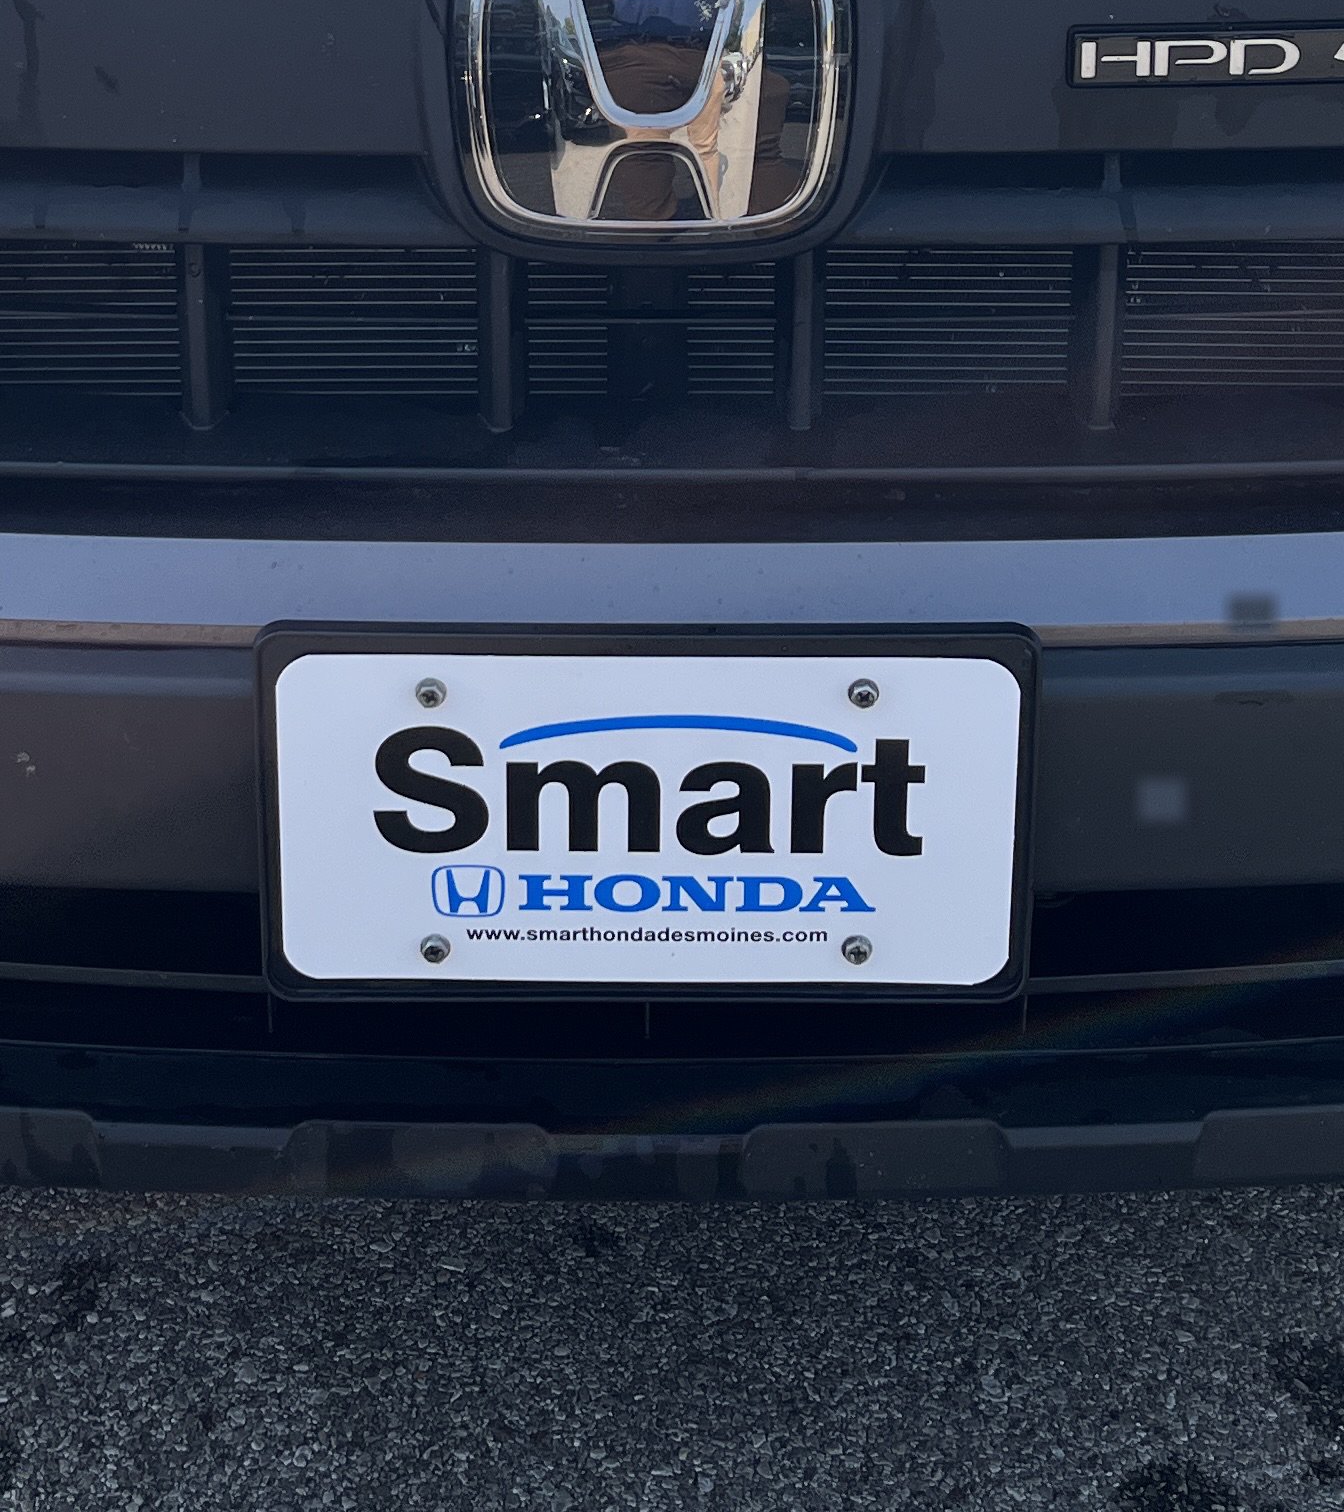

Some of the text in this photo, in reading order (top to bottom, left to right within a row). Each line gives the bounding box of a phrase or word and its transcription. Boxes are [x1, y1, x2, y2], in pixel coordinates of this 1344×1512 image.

[1080, 38, 1301, 80] HPD
[373, 725, 926, 856] Smart
[518, 873, 876, 913] HONDA
[466, 925, 829, 944] www.smarthondadesmoines.com
